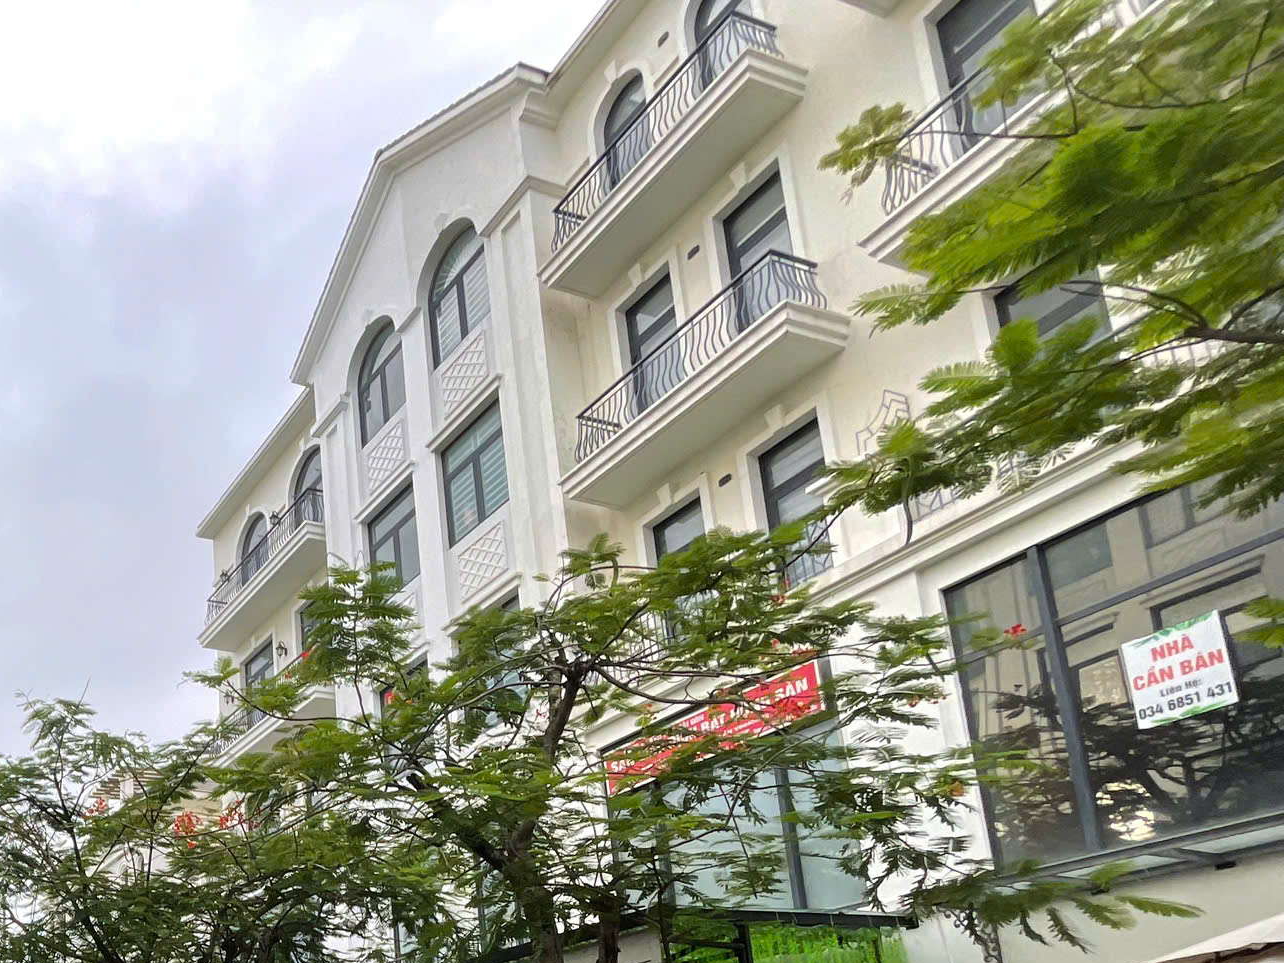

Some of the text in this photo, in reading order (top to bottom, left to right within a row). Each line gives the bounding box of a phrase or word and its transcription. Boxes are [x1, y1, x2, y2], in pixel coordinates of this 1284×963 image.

[1150, 634, 1194, 662] NHÀ
[1179, 649, 1225, 676] BÁN
[1138, 681, 1233, 720] 034 6851 431
